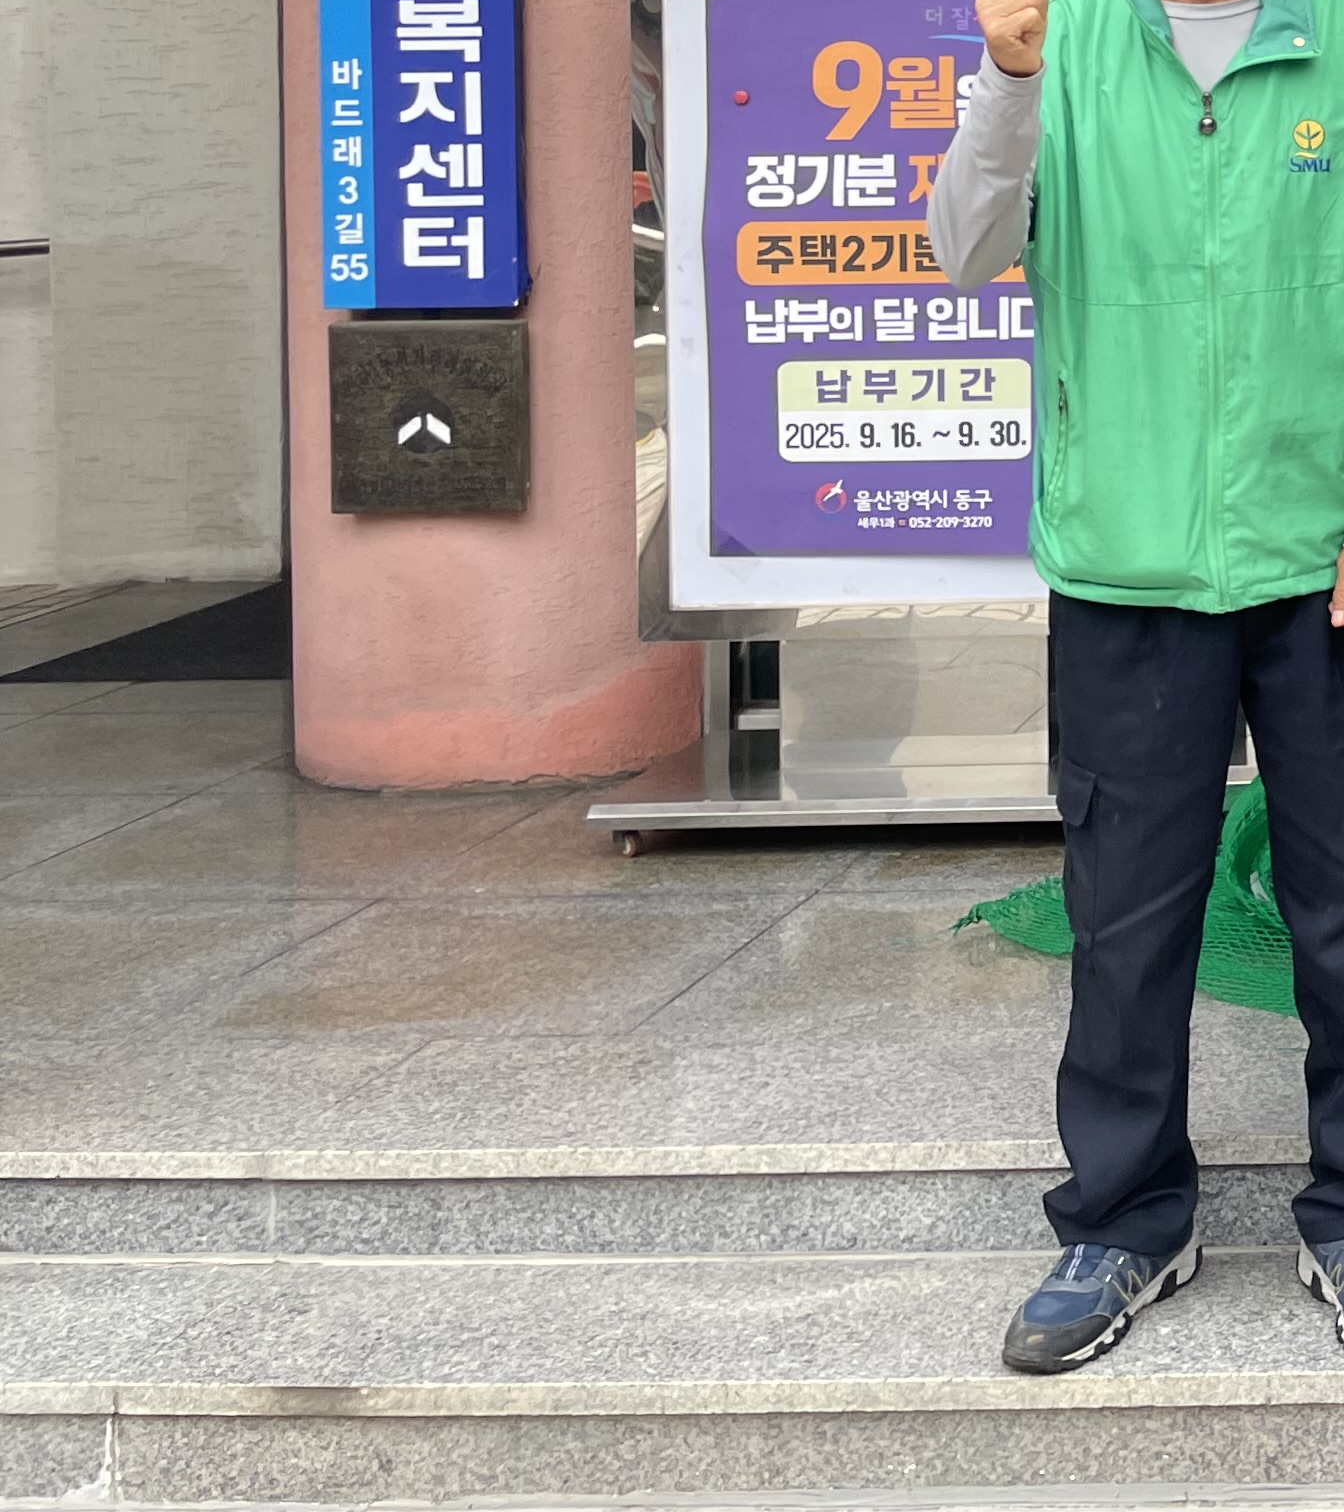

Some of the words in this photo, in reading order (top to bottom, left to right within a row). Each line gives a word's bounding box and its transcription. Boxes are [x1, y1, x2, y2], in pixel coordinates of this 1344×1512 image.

[925, 6, 943, 26] 더
[951, 6, 979, 31] 잘
[1290, 157, 1331, 173] SMU
[746, 154, 897, 208] 정기분
[330, 254, 369, 281] 55
[745, 299, 863, 343] 납부의
[874, 298, 918, 341] 달
[786, 423, 850, 449] 2025.
[860, 423, 881, 448] 9.
[891, 422, 922, 448] 16.
[959, 421, 980, 447] 9.
[990, 420, 1027, 446] 30.
[854, 489, 948, 511] 울산광역시
[953, 489, 993, 510] 동구
[857, 517, 895, 528] 세무1과
[909, 516, 993, 528] 052-209-3270
